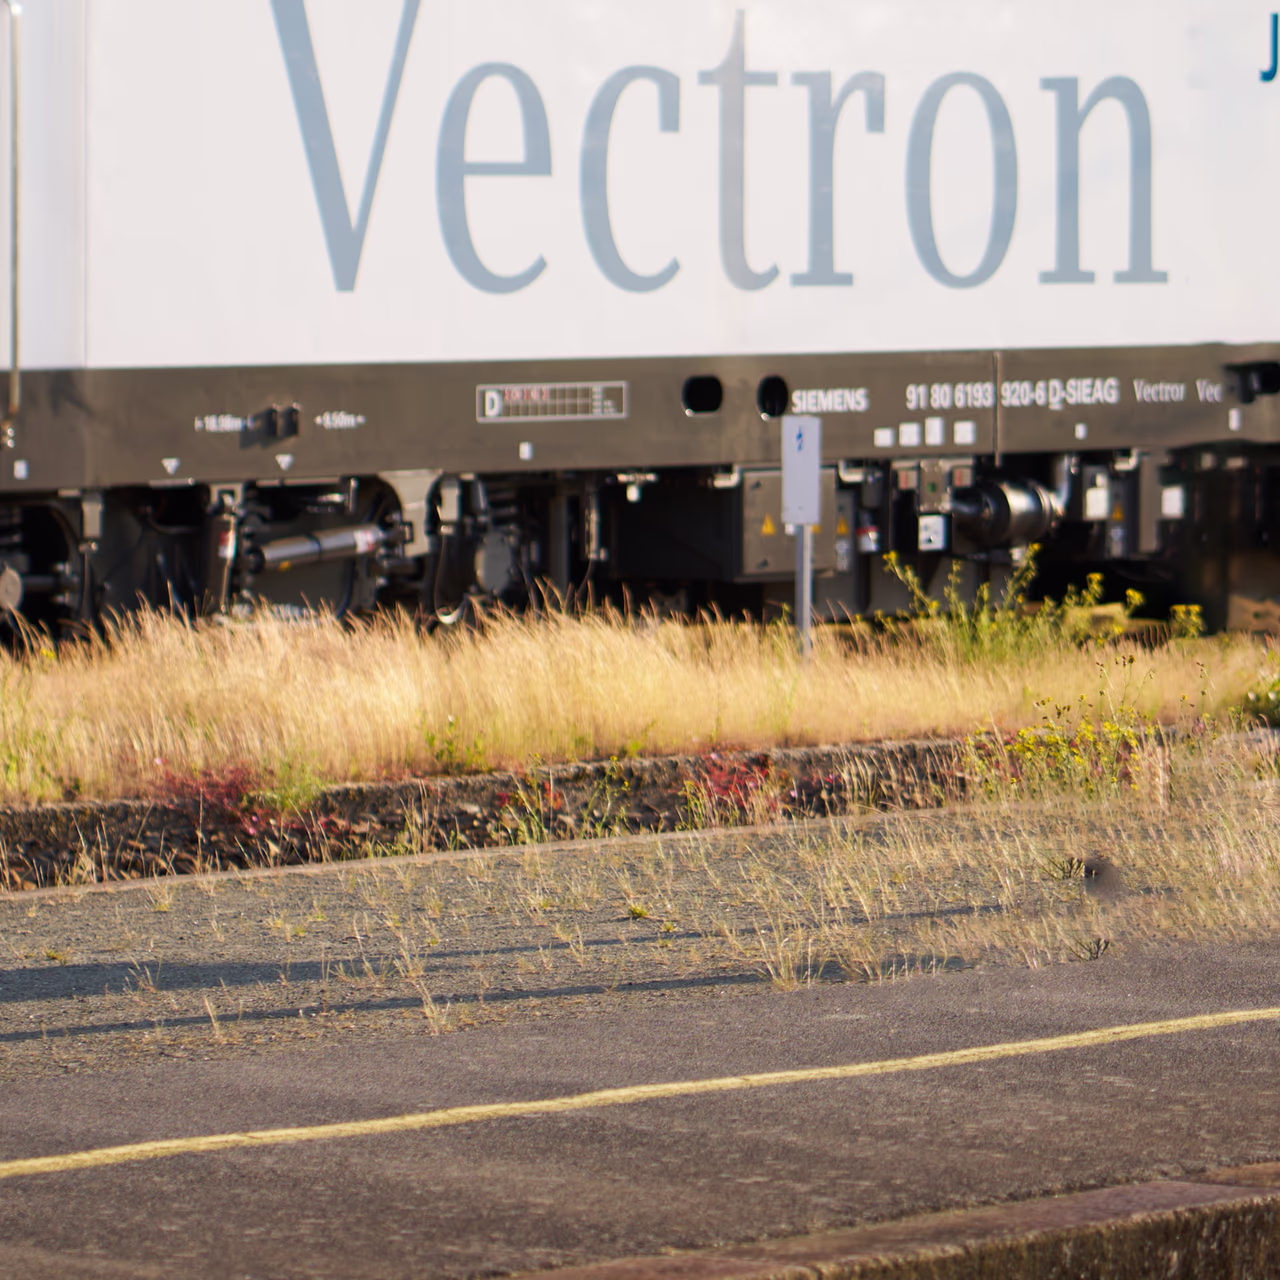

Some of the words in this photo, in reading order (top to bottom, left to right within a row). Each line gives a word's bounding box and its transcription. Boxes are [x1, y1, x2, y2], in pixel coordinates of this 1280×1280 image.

[791, 387, 869, 414] SIEMENS
[905, 383, 928, 410] 91
[930, 382, 952, 409] 80
[954, 381, 995, 408] 6193
[1000, 379, 1047, 407] 920-6
